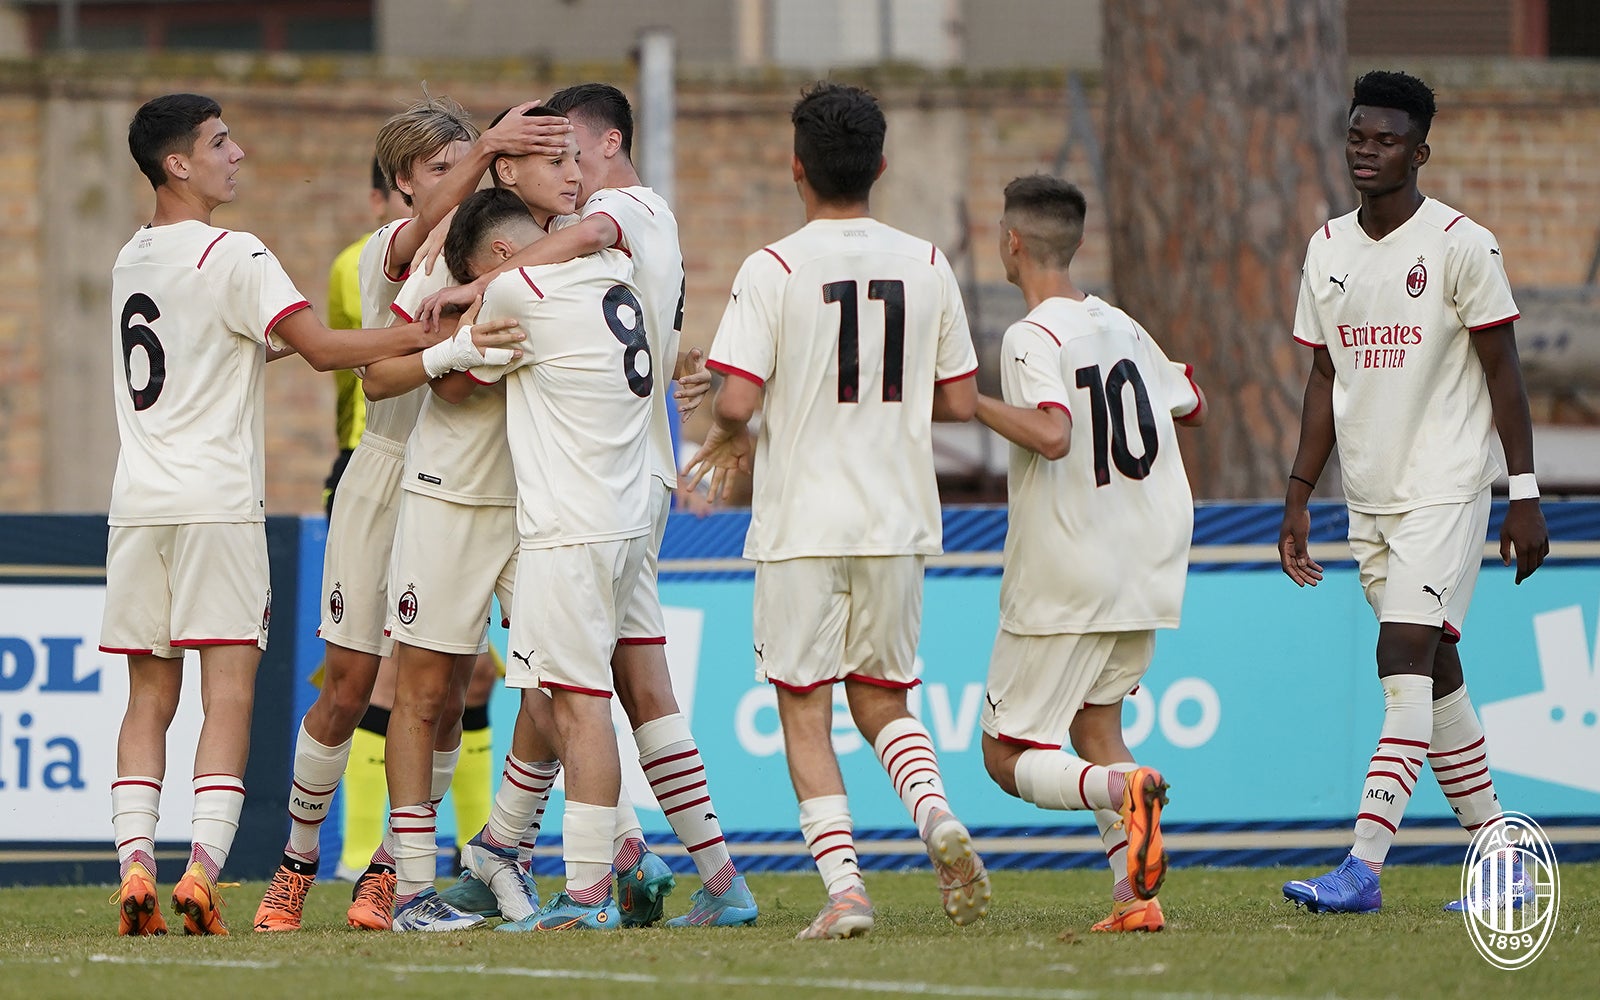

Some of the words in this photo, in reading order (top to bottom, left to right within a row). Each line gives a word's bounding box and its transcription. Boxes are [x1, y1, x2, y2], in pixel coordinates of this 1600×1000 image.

[121, 292, 166, 412] 6
[602, 284, 654, 398] 8
[822, 279, 905, 403] 11
[1336, 321, 1423, 348] Emirates
[1364, 349, 1406, 368] BETTER
[1075, 358, 1159, 487] 10
[0, 712, 85, 789] ia
[293, 797, 324, 810] ACM
[1366, 789, 1396, 805] ACM
